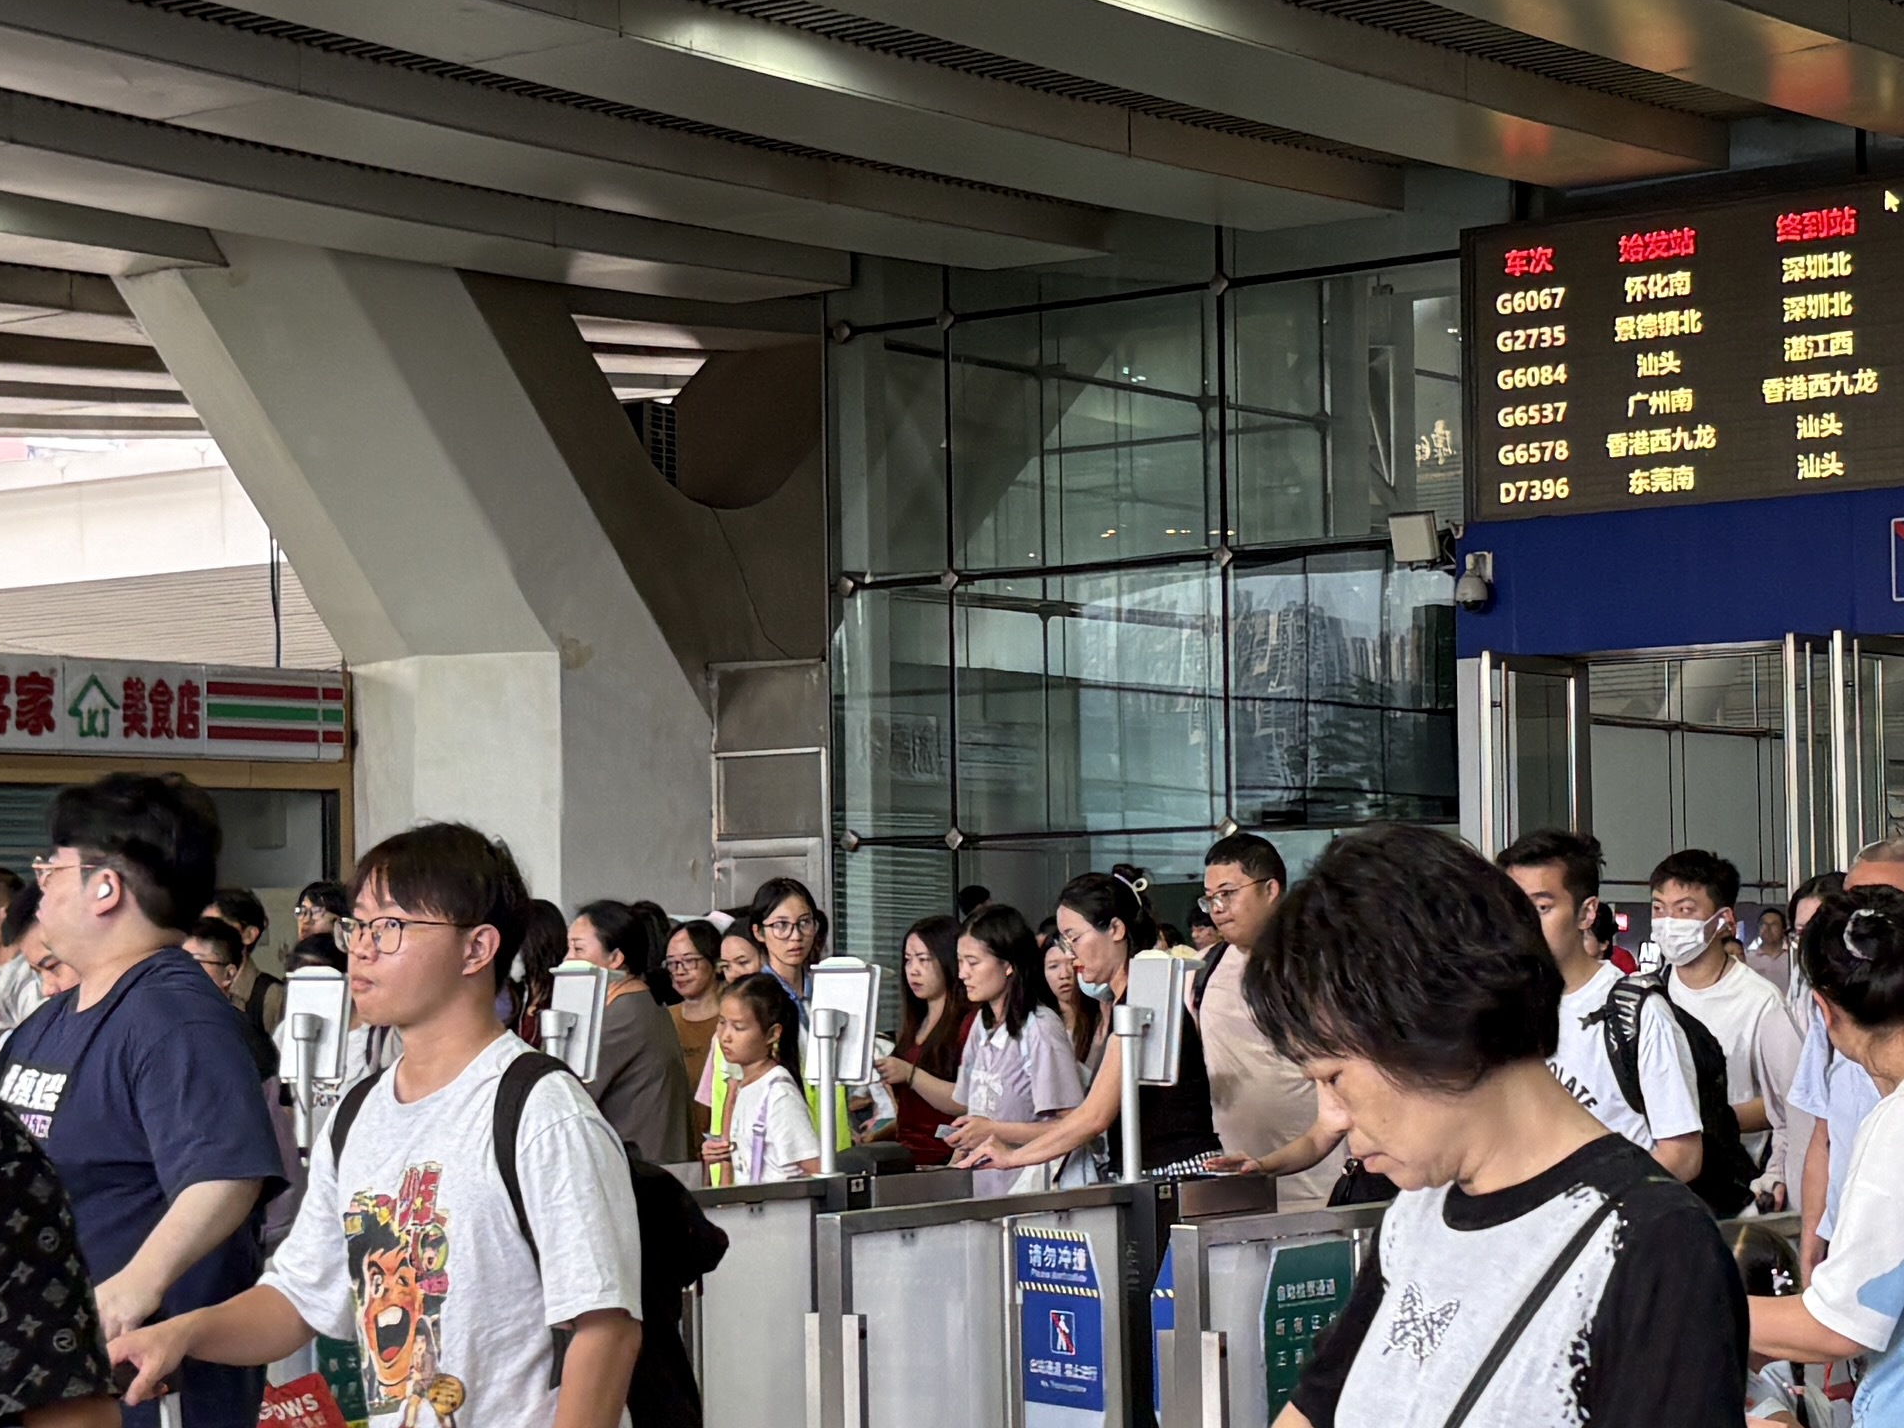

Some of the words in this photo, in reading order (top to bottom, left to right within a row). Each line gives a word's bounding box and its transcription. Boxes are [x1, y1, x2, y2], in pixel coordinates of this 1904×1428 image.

[1504, 246, 1554, 277] 车次
[1618, 226, 1696, 263] 始发站
[1775, 206, 1857, 243] 终到站
[1496, 286, 1566, 315] G6067
[1624, 270, 1692, 303] 怀化南
[1781, 250, 1853, 283] 深圳北
[1496, 324, 1566, 353] G2735
[1614, 308, 1703, 343] 景德镇北
[1782, 290, 1854, 323] 深圳北
[1497, 363, 1568, 390] G6084
[1636, 350, 1682, 378] 汕头
[1783, 330, 1854, 362] 湛江西
[1497, 401, 1568, 428] G6537
[1627, 386, 1694, 418] 广州南
[1761, 367, 1879, 404] 香港西九龙
[1497, 439, 1570, 466] G6578
[1605, 423, 1717, 458] 香港西九龙
[1796, 412, 1844, 440] 汕头
[1499, 476, 1570, 504] D7396
[1628, 464, 1695, 495] 东莞南
[1796, 450, 1845, 480] 汕头
[1028, 1243, 1087, 1271] 请勿冲撞
